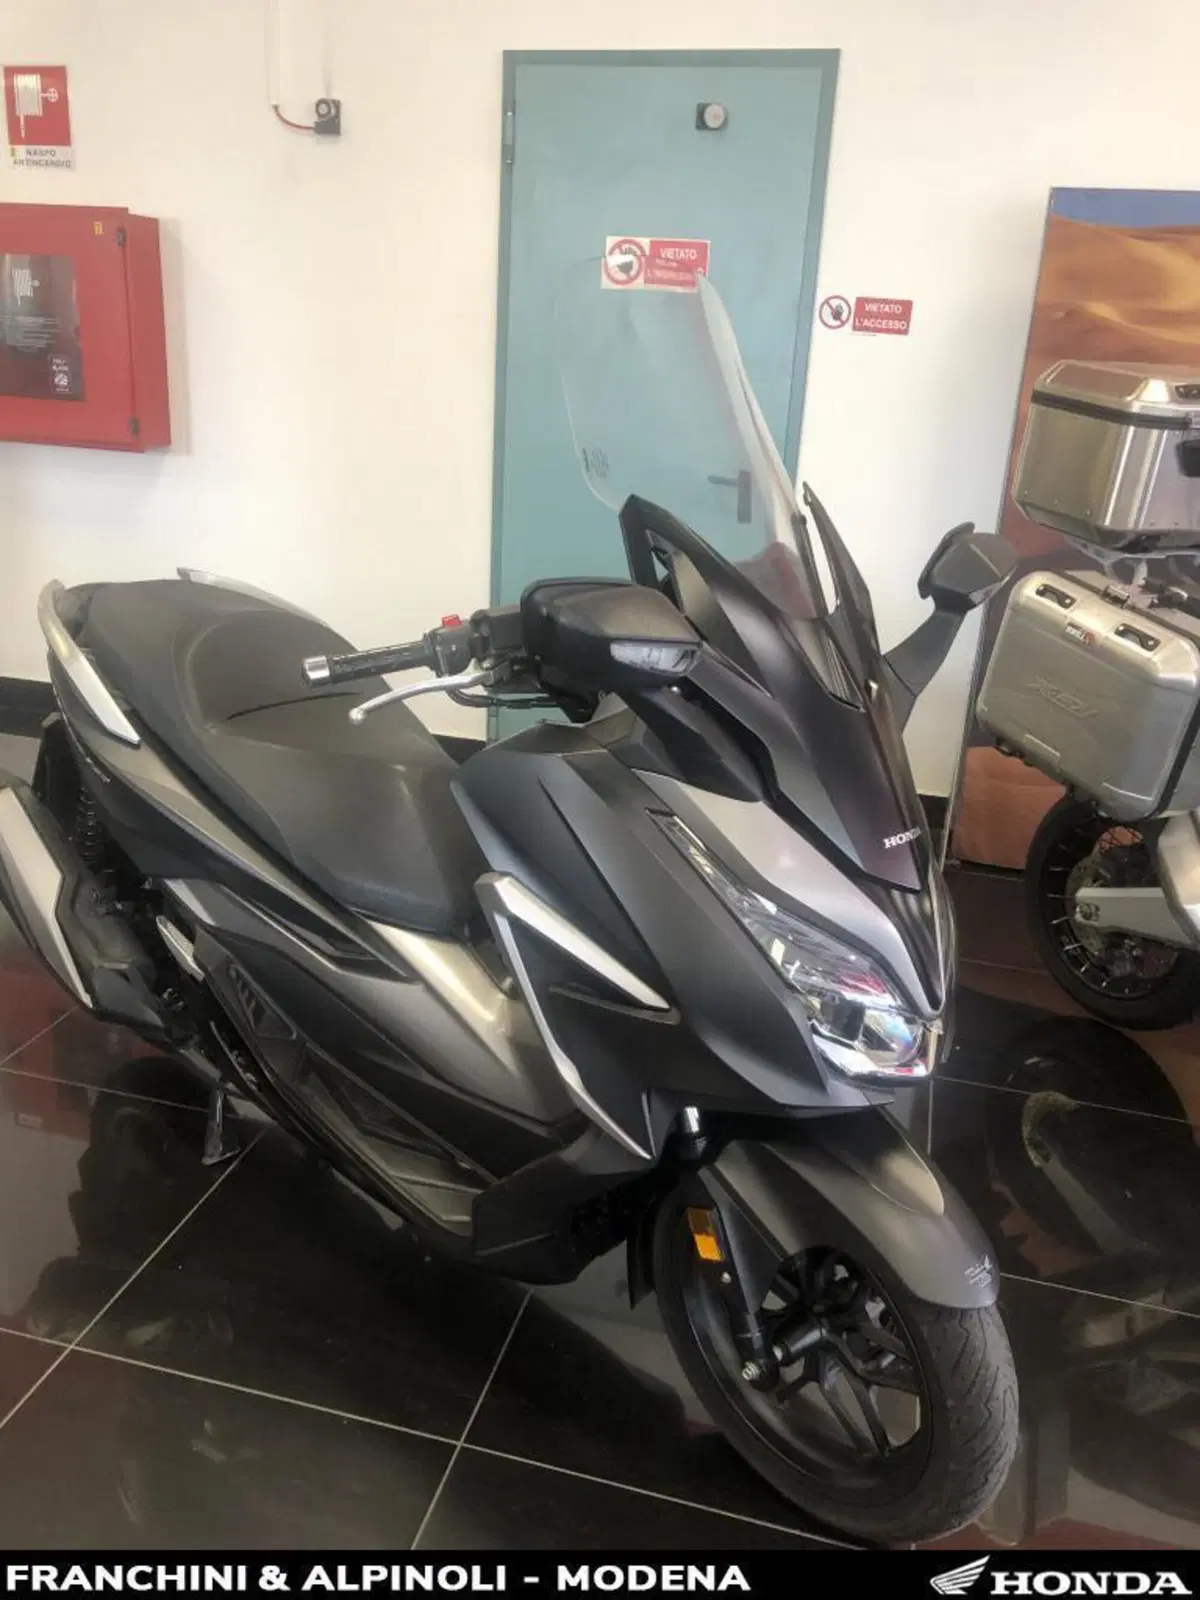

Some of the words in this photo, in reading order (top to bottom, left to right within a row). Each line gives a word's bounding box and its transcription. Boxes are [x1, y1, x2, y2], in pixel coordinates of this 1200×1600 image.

[659, 247, 698, 261] VIETATO
[864, 302, 903, 314] VIETATO
[855, 317, 907, 329] L'ACCESSO
